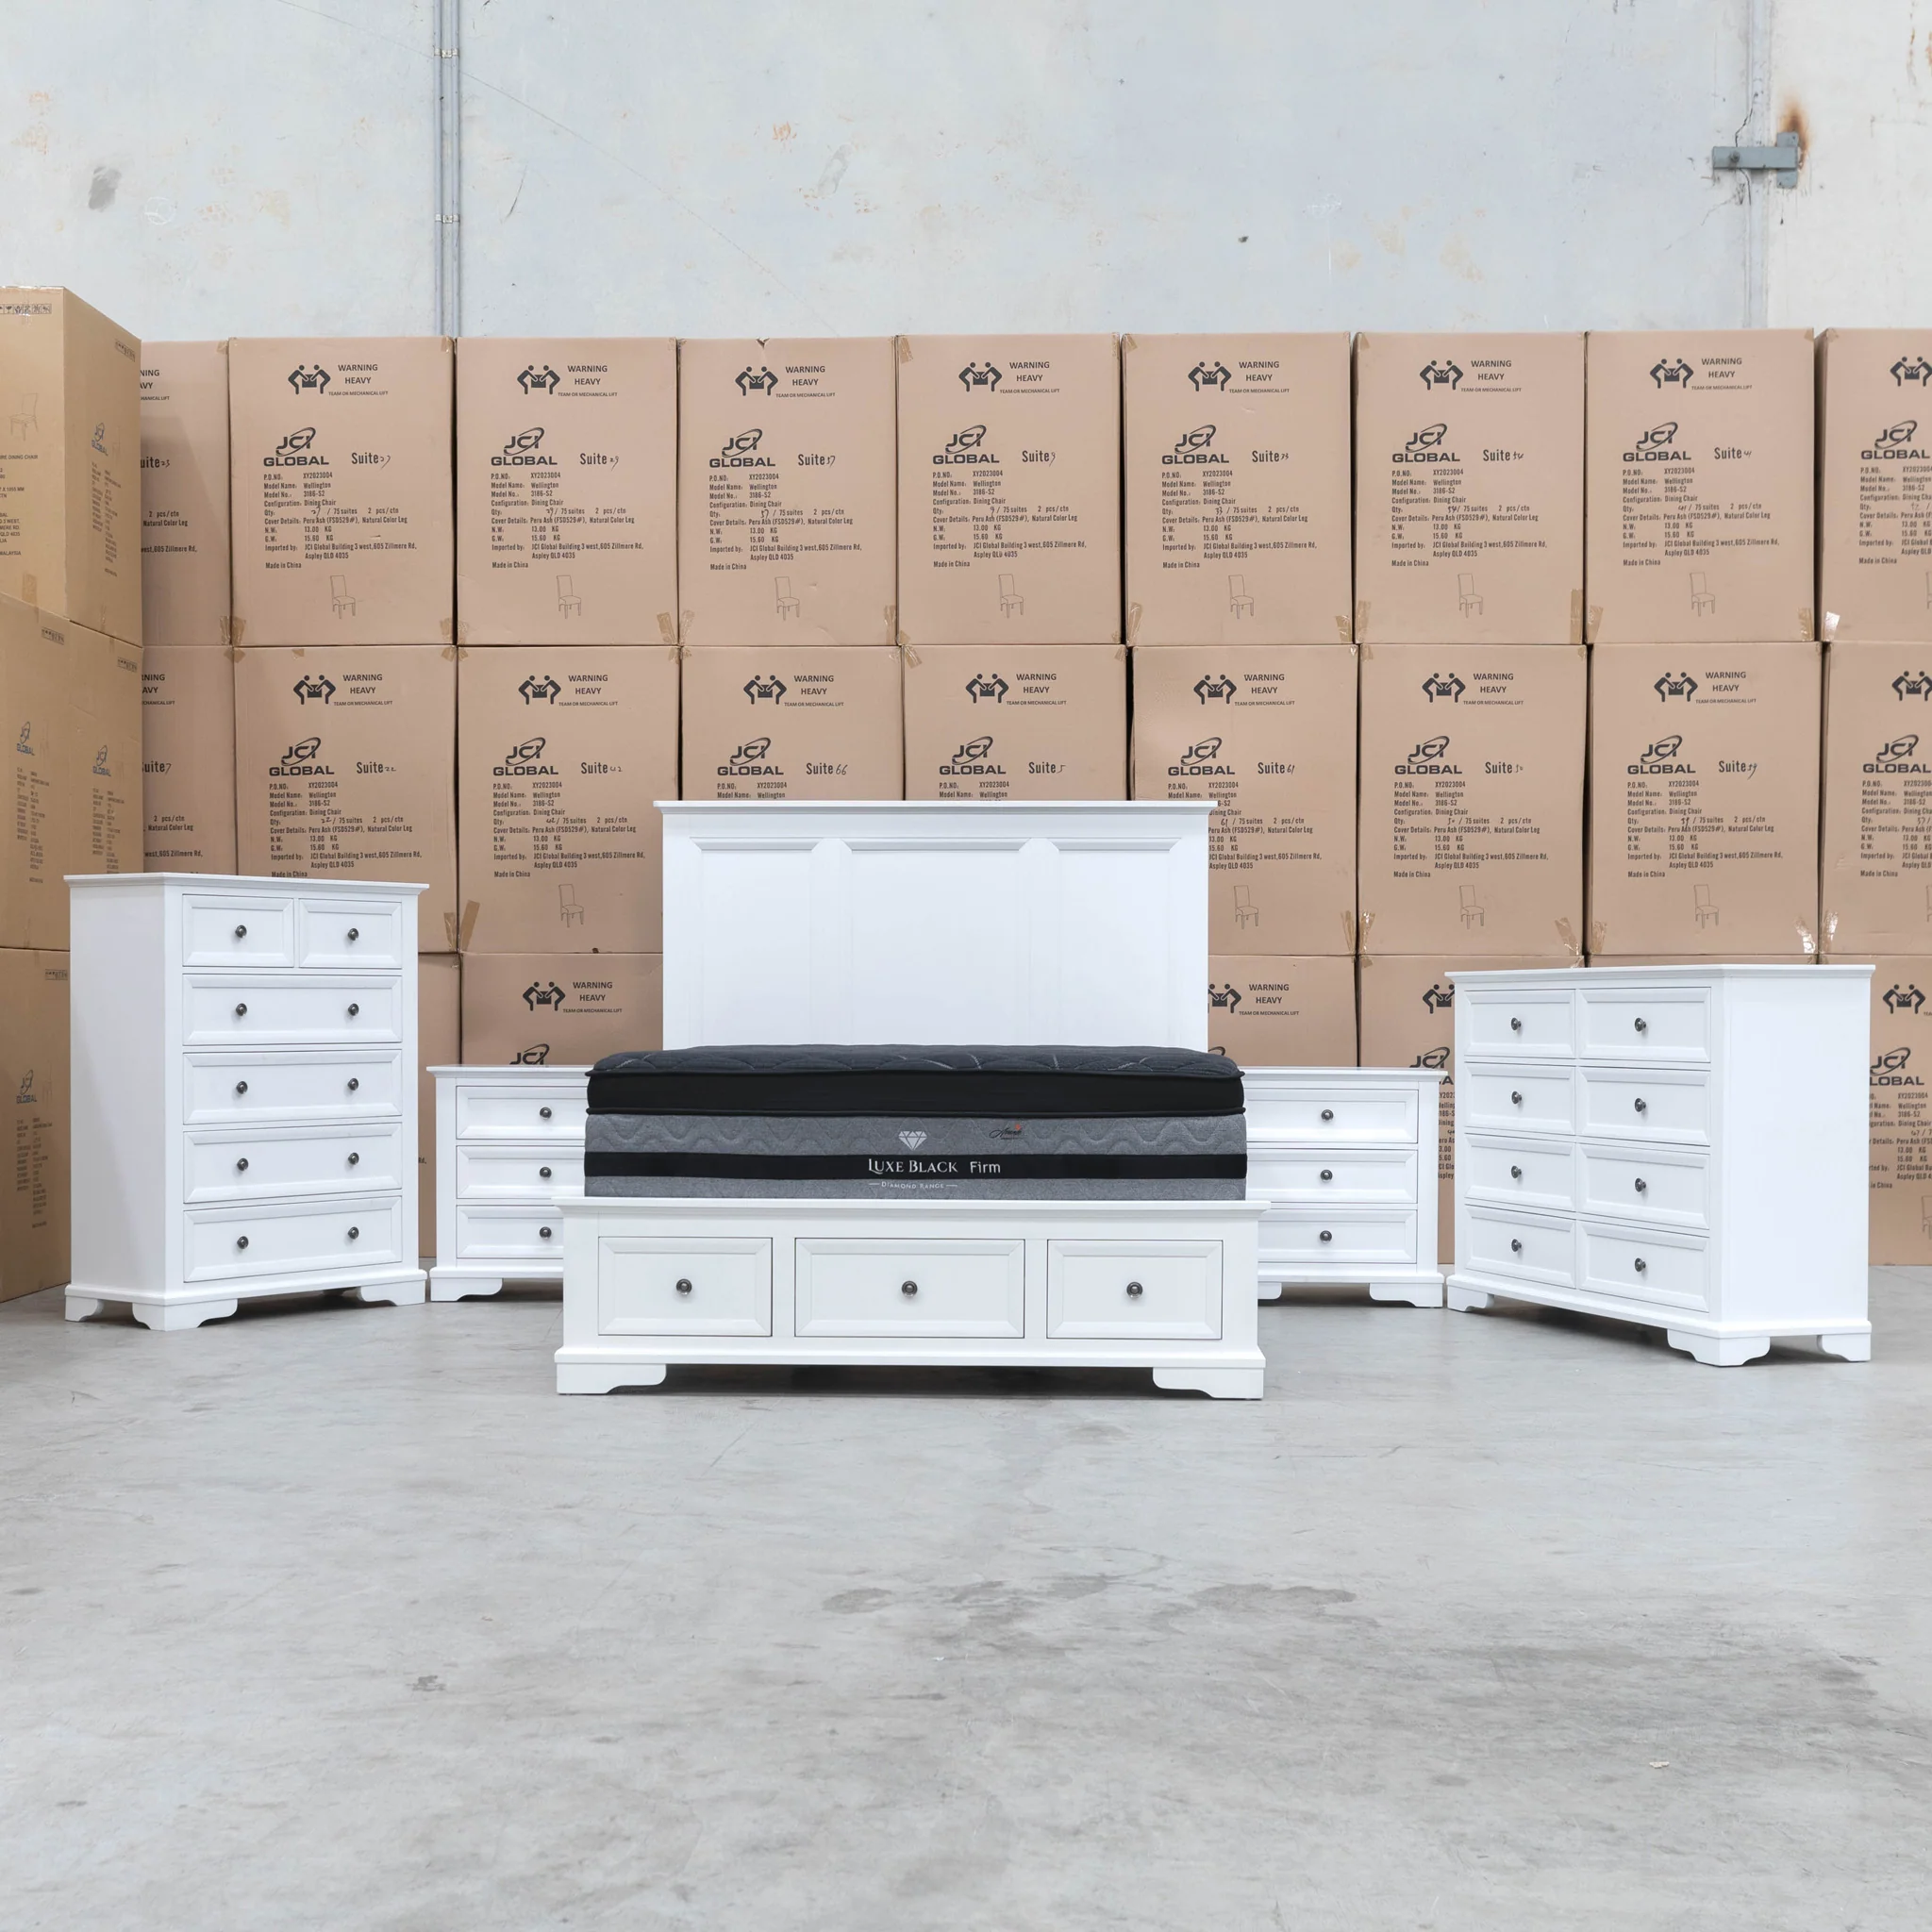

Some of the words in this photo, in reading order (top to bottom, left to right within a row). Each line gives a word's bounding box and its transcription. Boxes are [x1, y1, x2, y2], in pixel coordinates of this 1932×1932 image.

[945, 429, 984, 452] JCI
[1174, 429, 1214, 453] JCI
[1405, 427, 1444, 451] JCI
[1636, 426, 1675, 450] JCI
[1874, 425, 1914, 448] JCI
[275, 432, 314, 455] JCI
[503, 432, 542, 455] JCI
[722, 433, 760, 456] JCI
[352, 452, 378, 464] Suite
[580, 453, 607, 465] Suite
[933, 453, 1000, 464] GLOBAL
[1022, 450, 1050, 463] Suite
[1162, 453, 1229, 464] GLOBAL
[1252, 450, 1279, 462] Suite
[1392, 451, 1460, 462] GLOBAL
[1483, 449, 1510, 461] Suite
[1623, 450, 1691, 462] GLOBAL
[1714, 447, 1741, 459] Suite
[1861, 448, 1930, 459] GLOBAL
[141, 457, 159, 468] uite
[263, 455, 329, 467] GLOBAL
[491, 455, 558, 466] GLOBAL
[709, 457, 775, 468] GLOBAL
[798, 454, 824, 466] Suite
[777, 544, 799, 553] Building
[281, 741, 319, 764] JCI
[505, 741, 544, 764] JCI
[729, 741, 769, 764] JCI
[952, 741, 991, 763] JCI
[1180, 741, 1220, 764] JCI
[1407, 741, 1447, 763] JCI
[1641, 740, 1680, 763] JCI
[1875, 740, 1915, 762] JCI
[269, 765, 335, 776] GLOBAL
[357, 761, 383, 774] Suite
[493, 764, 558, 776] GLOBAL
[581, 762, 608, 774] Suite
[717, 764, 784, 775] GLOBAL
[807, 762, 833, 774] Suite
[940, 764, 1007, 774] GLOBAL
[1029, 761, 1056, 774] Suite
[1168, 764, 1235, 775] GLOBAL
[1257, 762, 1285, 774] Suite
[1395, 763, 1462, 774] GLOBAL
[1485, 762, 1512, 774] Suite
[1627, 763, 1696, 774] GLOBAL
[1719, 760, 1746, 773] Suite
[1863, 762, 1931, 774] GLOBAL
[1870, 1052, 1908, 1074] JCI
[1870, 1076, 1924, 1086] LOBAL
[869, 1158, 904, 1174] LUXE
[909, 1160, 958, 1173] BLACK
[970, 1161, 1001, 1174] Firm
